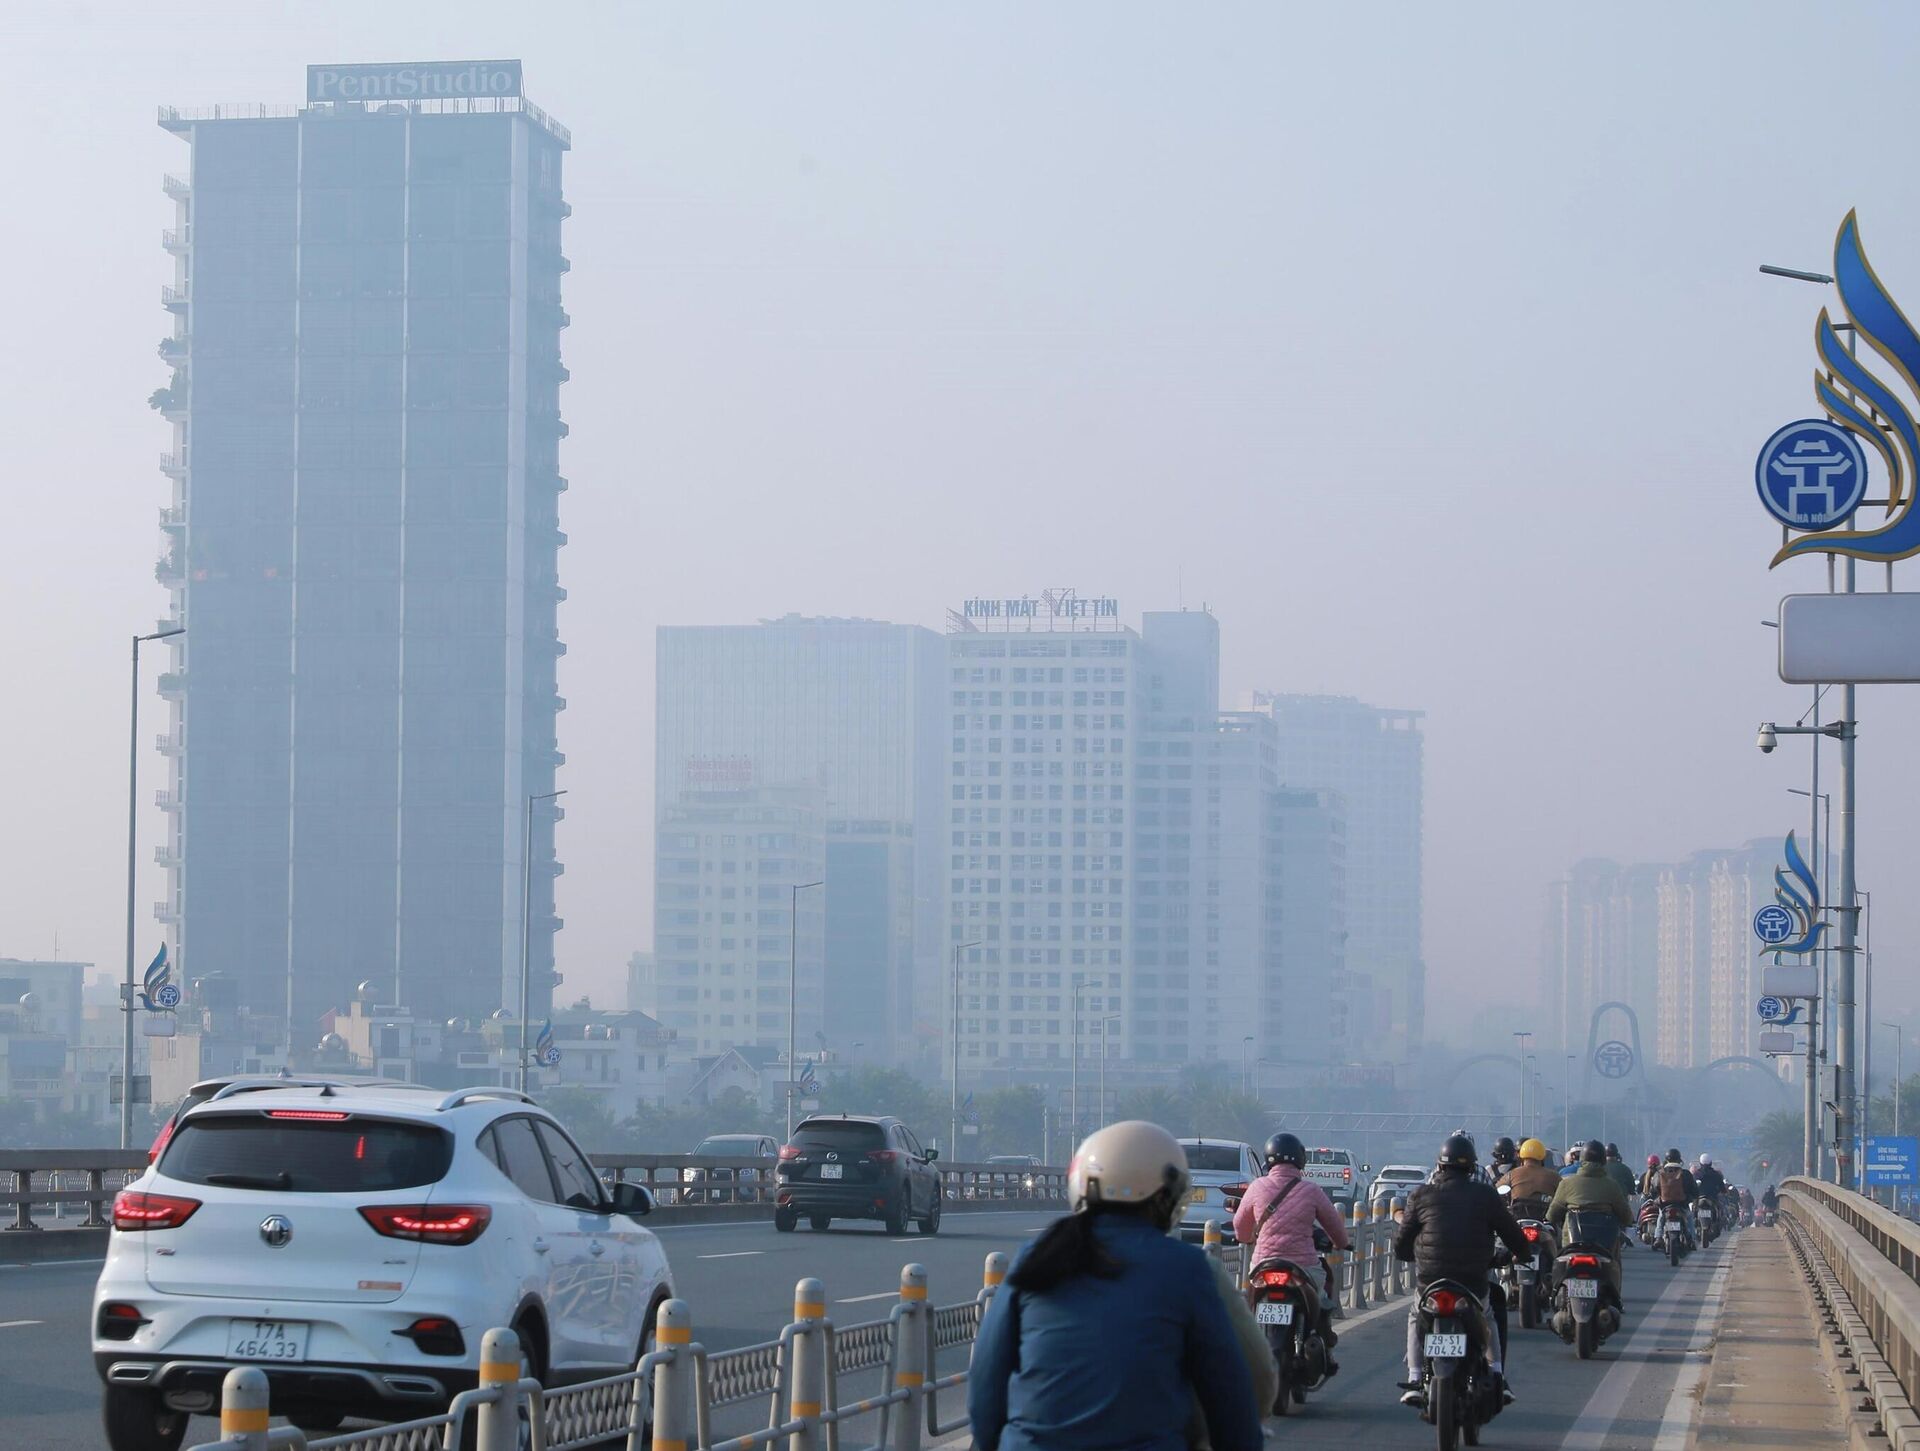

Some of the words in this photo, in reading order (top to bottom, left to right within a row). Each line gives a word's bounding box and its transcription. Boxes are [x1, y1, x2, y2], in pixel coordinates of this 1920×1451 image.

[315, 65, 513, 97] PentStudio
[963, 596, 1000, 617] KÍNH
[1094, 594, 1117, 617] TÍN
[1317, 1171, 1344, 1179] AUTO
[1258, 1313, 1290, 1324] 966.71
[255, 1323, 285, 1340] 17A
[235, 1340, 297, 1358] 464.33
[1427, 1345, 1463, 1356] 704.24
